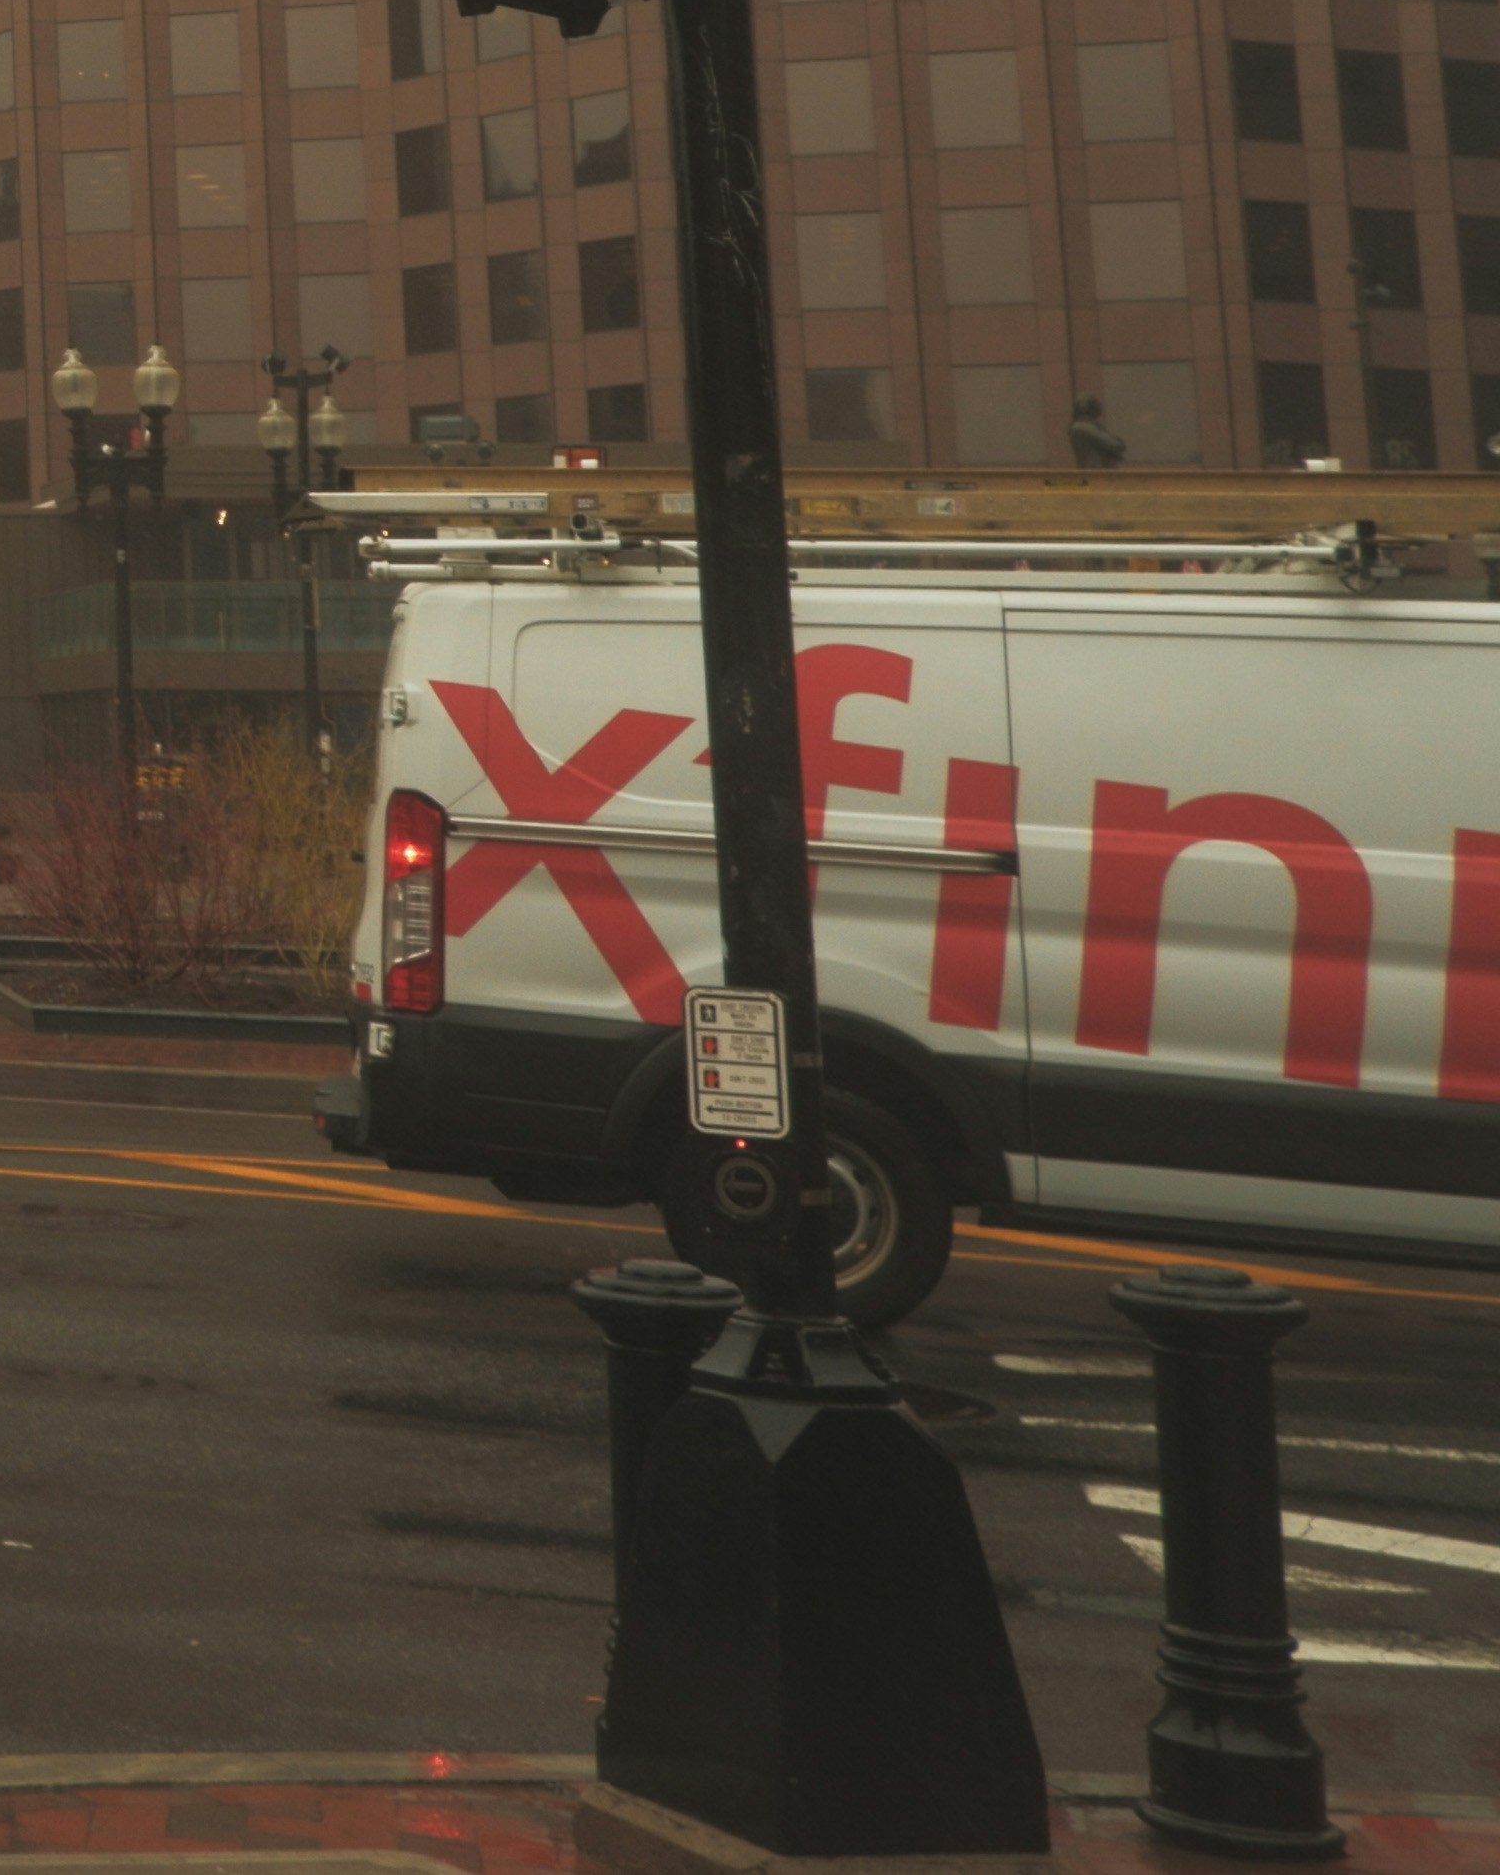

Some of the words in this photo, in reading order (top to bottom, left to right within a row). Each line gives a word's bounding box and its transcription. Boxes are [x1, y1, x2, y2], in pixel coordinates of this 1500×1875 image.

[729, 1074, 746, 1082] DON'T
[748, 1076, 767, 1085] CROSS
[714, 1098, 734, 1106] PUSH
[736, 1100, 763, 1109] BUTTON
[721, 1114, 732, 1122] TO
[733, 1114, 757, 1124] CROSS
